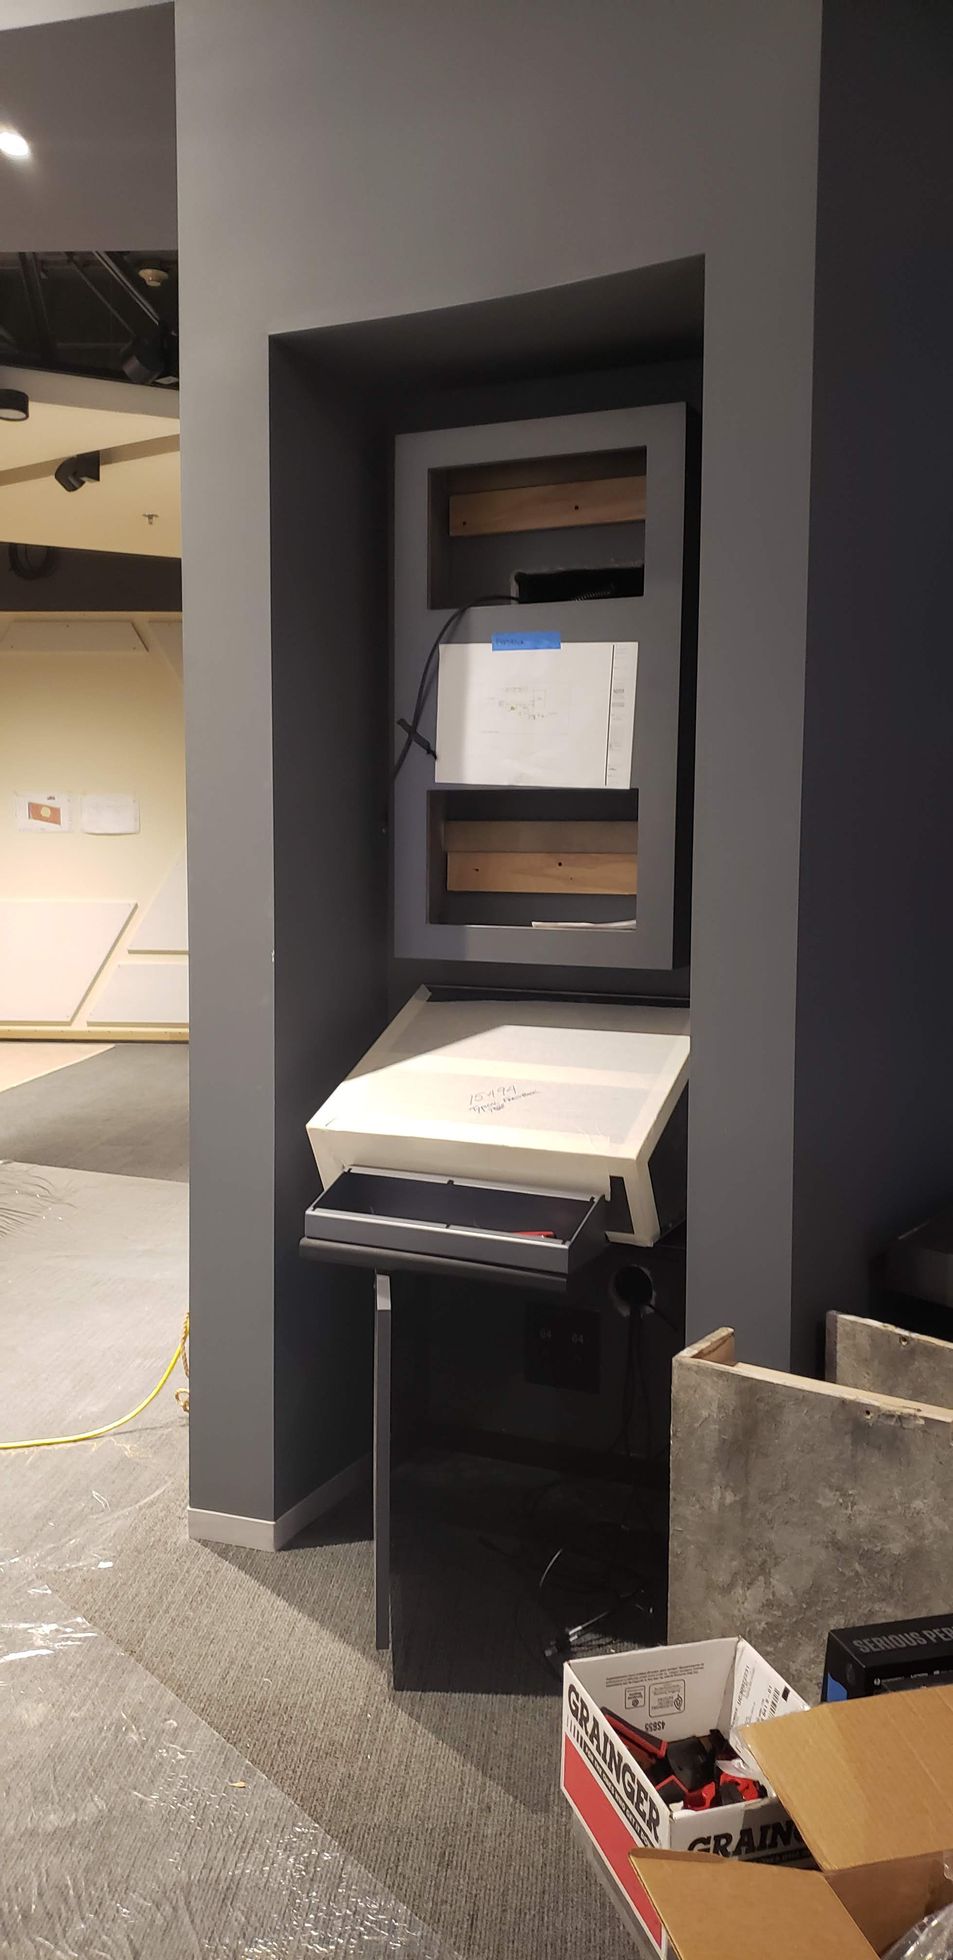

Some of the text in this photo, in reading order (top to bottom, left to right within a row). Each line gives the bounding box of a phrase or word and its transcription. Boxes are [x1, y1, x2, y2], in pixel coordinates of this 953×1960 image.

[852, 1626, 953, 1653] SERIOUS PER
[567, 1683, 660, 1843] GRAINGER
[688, 1820, 801, 1858] GRAIN
